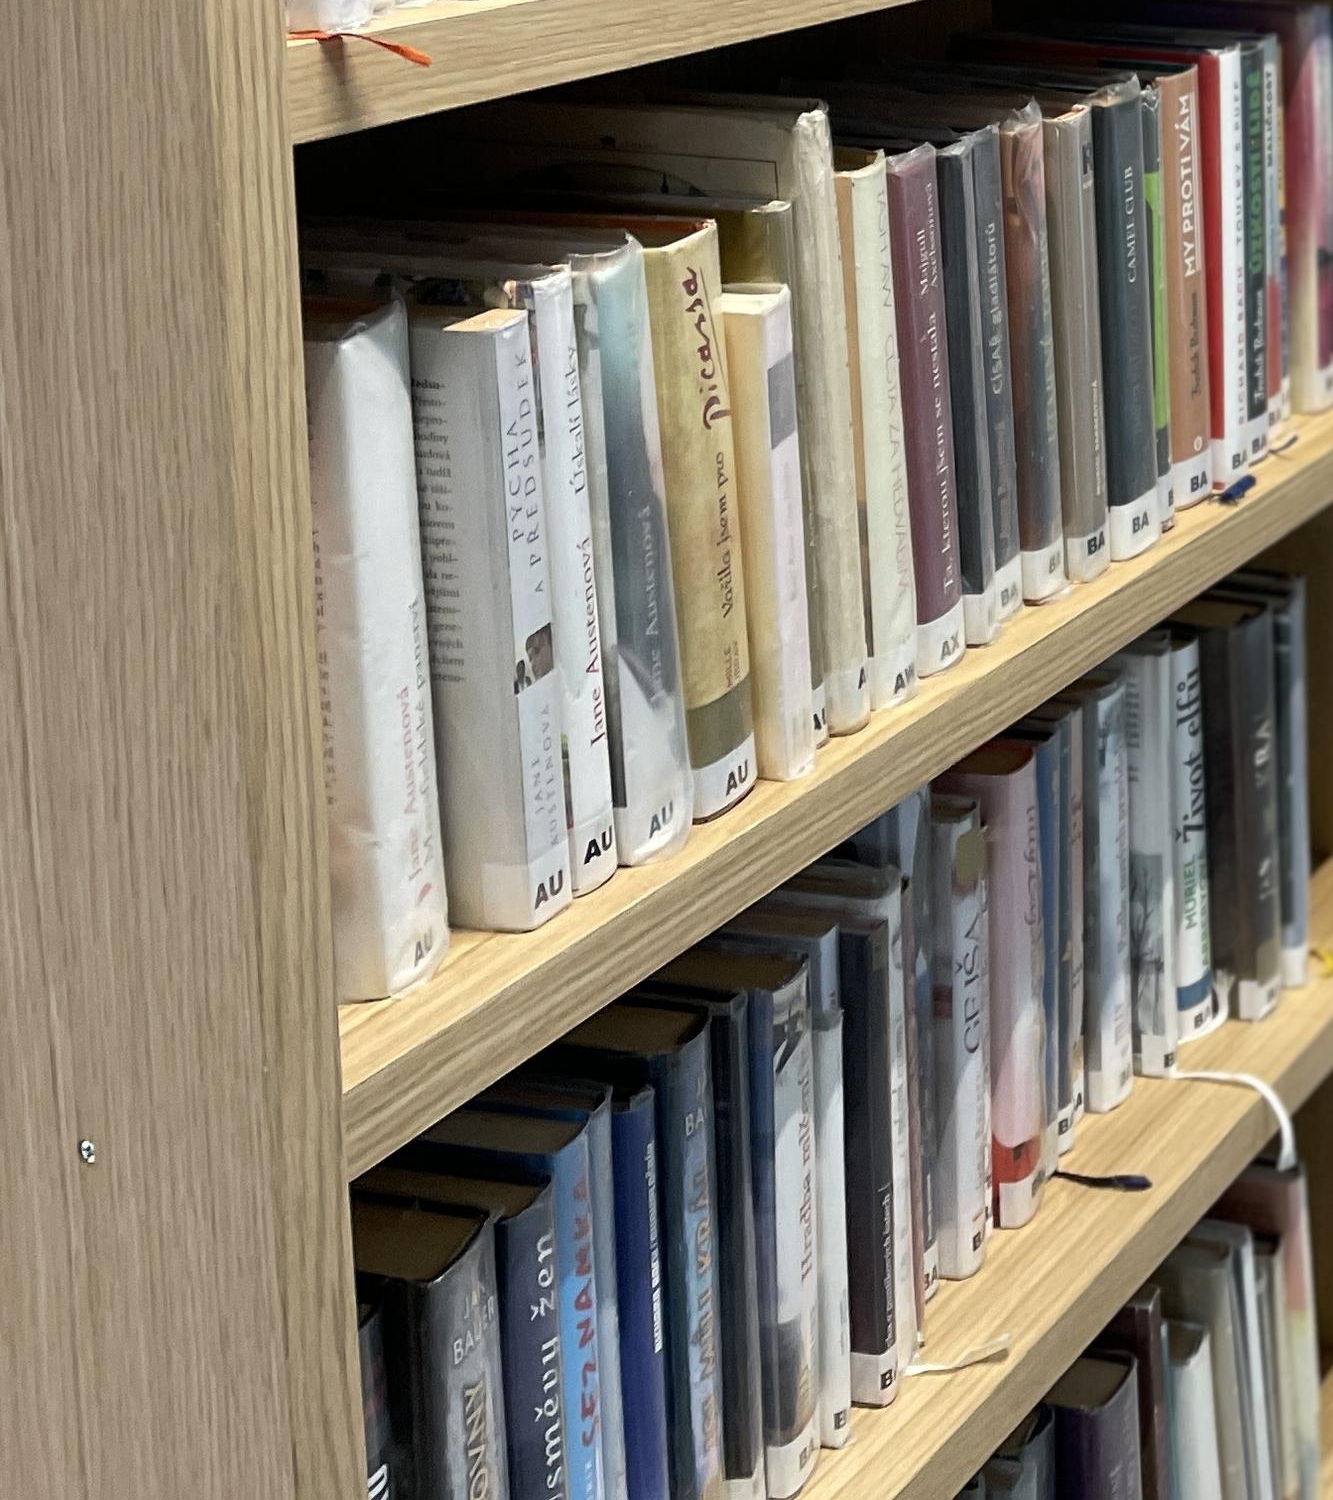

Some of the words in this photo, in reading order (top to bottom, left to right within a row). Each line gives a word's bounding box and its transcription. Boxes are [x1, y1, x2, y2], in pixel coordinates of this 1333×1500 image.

[1174, 94, 1191, 151] VÁM
[1124, 165, 1135, 215] CLUB
[1180, 156, 1194, 225] PROTI
[1125, 222, 1138, 284] CAMEL
[1182, 241, 1196, 278] MY
[926, 311, 940, 389] nestala
[564, 347, 582, 408] lásky
[933, 397, 941, 418] se
[933, 424, 948, 476] jsem
[1251, 435, 1267, 455] BA
[714, 451, 728, 486] pro
[1189, 474, 1208, 493] BA
[714, 493, 734, 546] jsem
[935, 480, 952, 554] kterou
[1131, 512, 1149, 534] BA
[1086, 530, 1105, 556] BA
[532, 579, 545, 594] A
[639, 504, 661, 637] Austenová
[715, 550, 736, 619] Vařila
[576, 535, 602, 675] Austenová
[940, 635, 961, 661] AX
[589, 687, 608, 748] Jane
[726, 759, 749, 797] AU
[648, 800, 674, 839] AU
[583, 825, 614, 865] AU
[534, 869, 564, 910] AU
[413, 932, 433, 966] AU
[530, 1226, 555, 1322] žen
